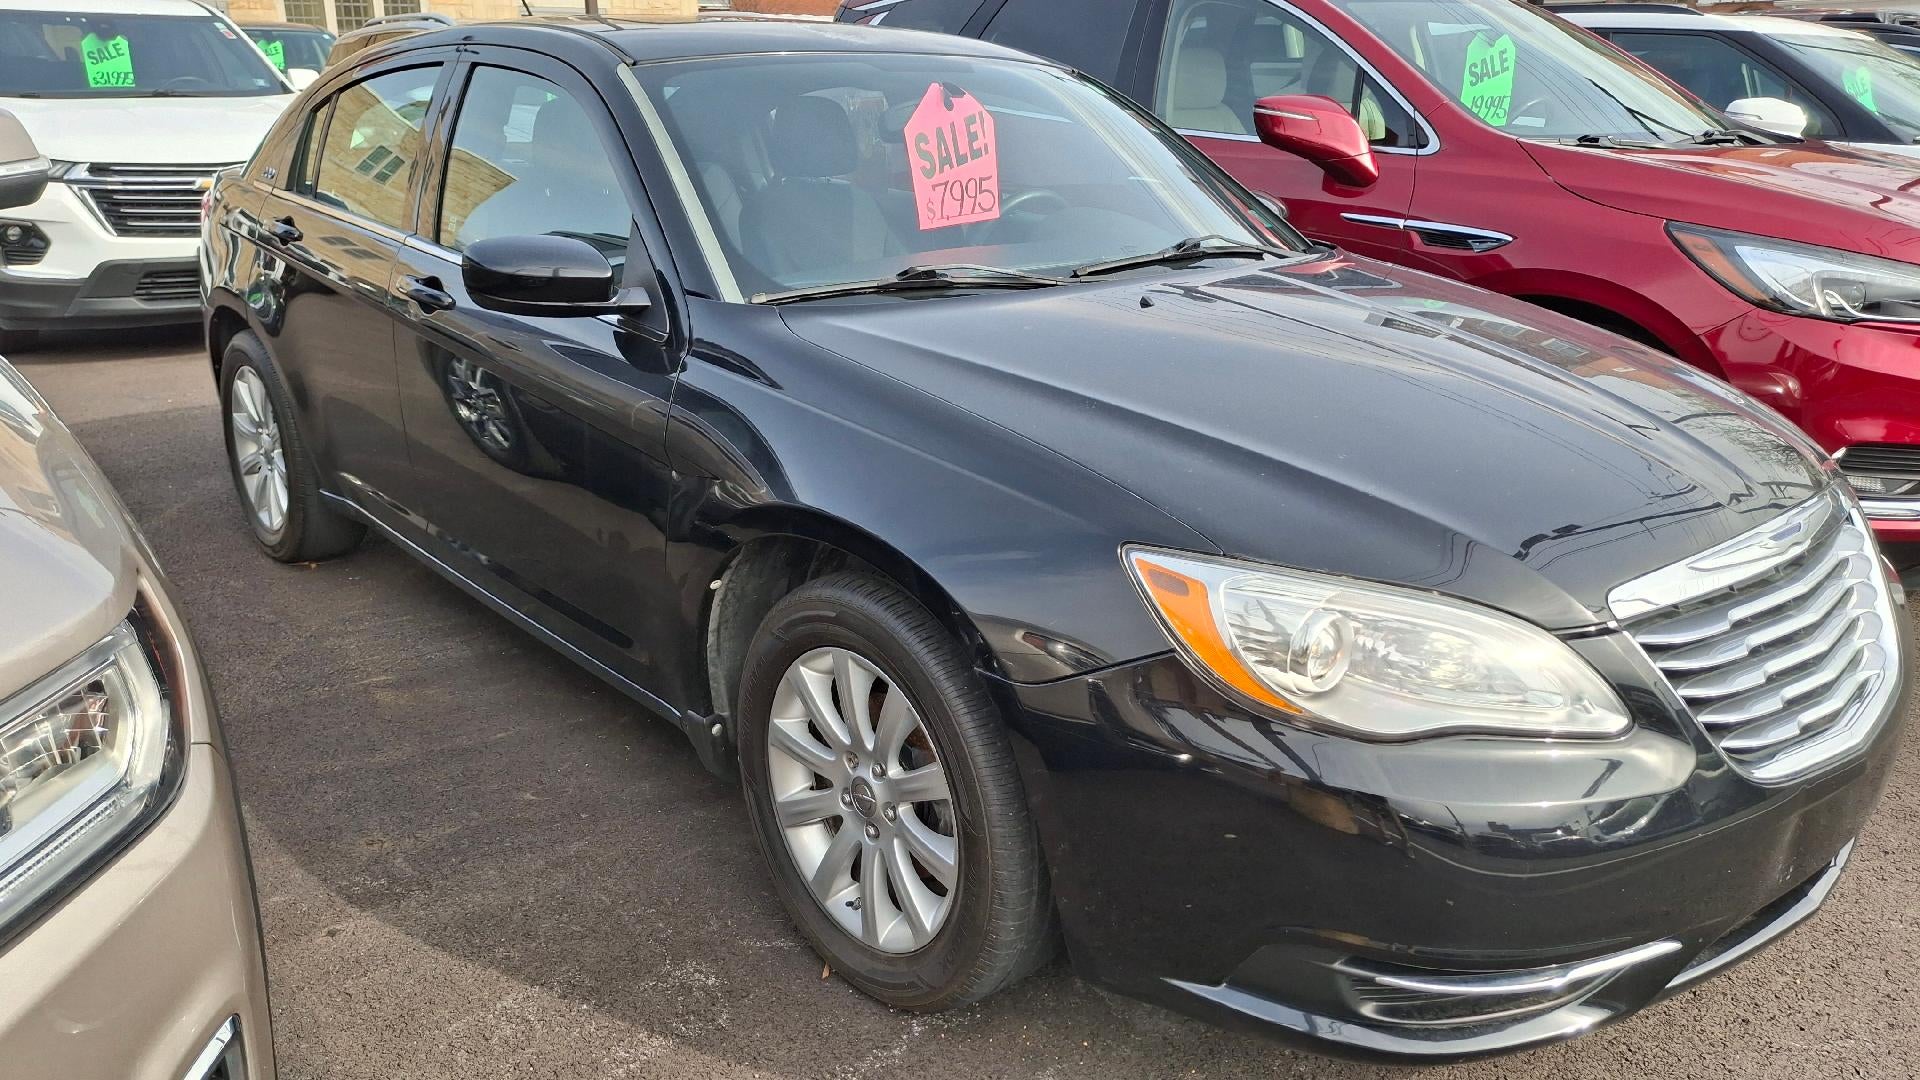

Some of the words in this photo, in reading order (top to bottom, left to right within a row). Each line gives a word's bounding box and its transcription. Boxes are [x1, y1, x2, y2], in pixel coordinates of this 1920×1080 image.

[87, 43, 125, 65] SALE
[1468, 48, 1509, 87] SALE
[915, 111, 989, 180] SALE!
[926, 175, 996, 224] $7,995
